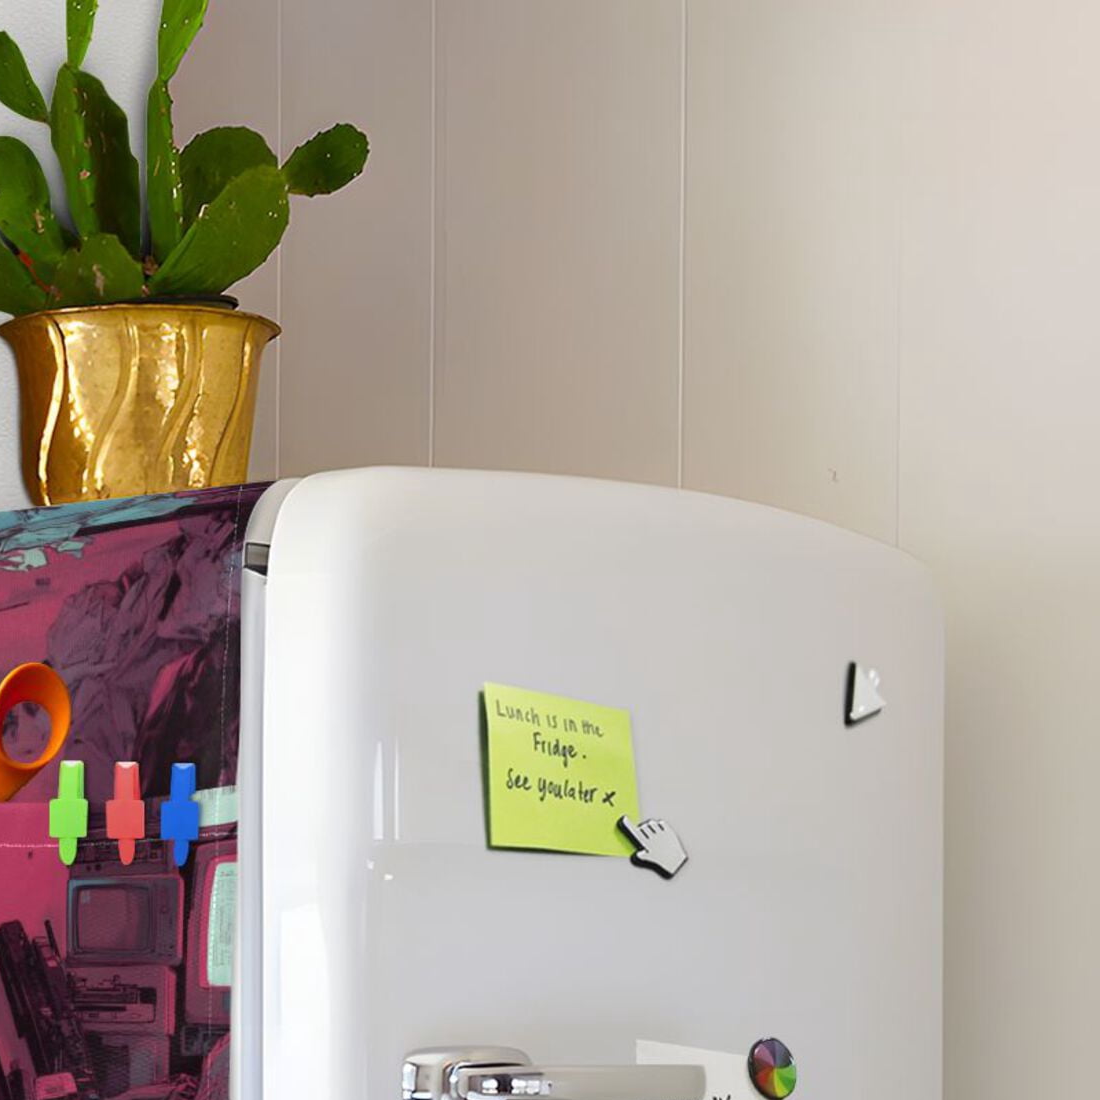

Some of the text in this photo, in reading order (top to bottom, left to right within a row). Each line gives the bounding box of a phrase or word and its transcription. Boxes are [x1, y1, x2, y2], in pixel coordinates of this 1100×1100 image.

[496, 699, 603, 737] Lunch is in the
[506, 768, 531, 791] See
